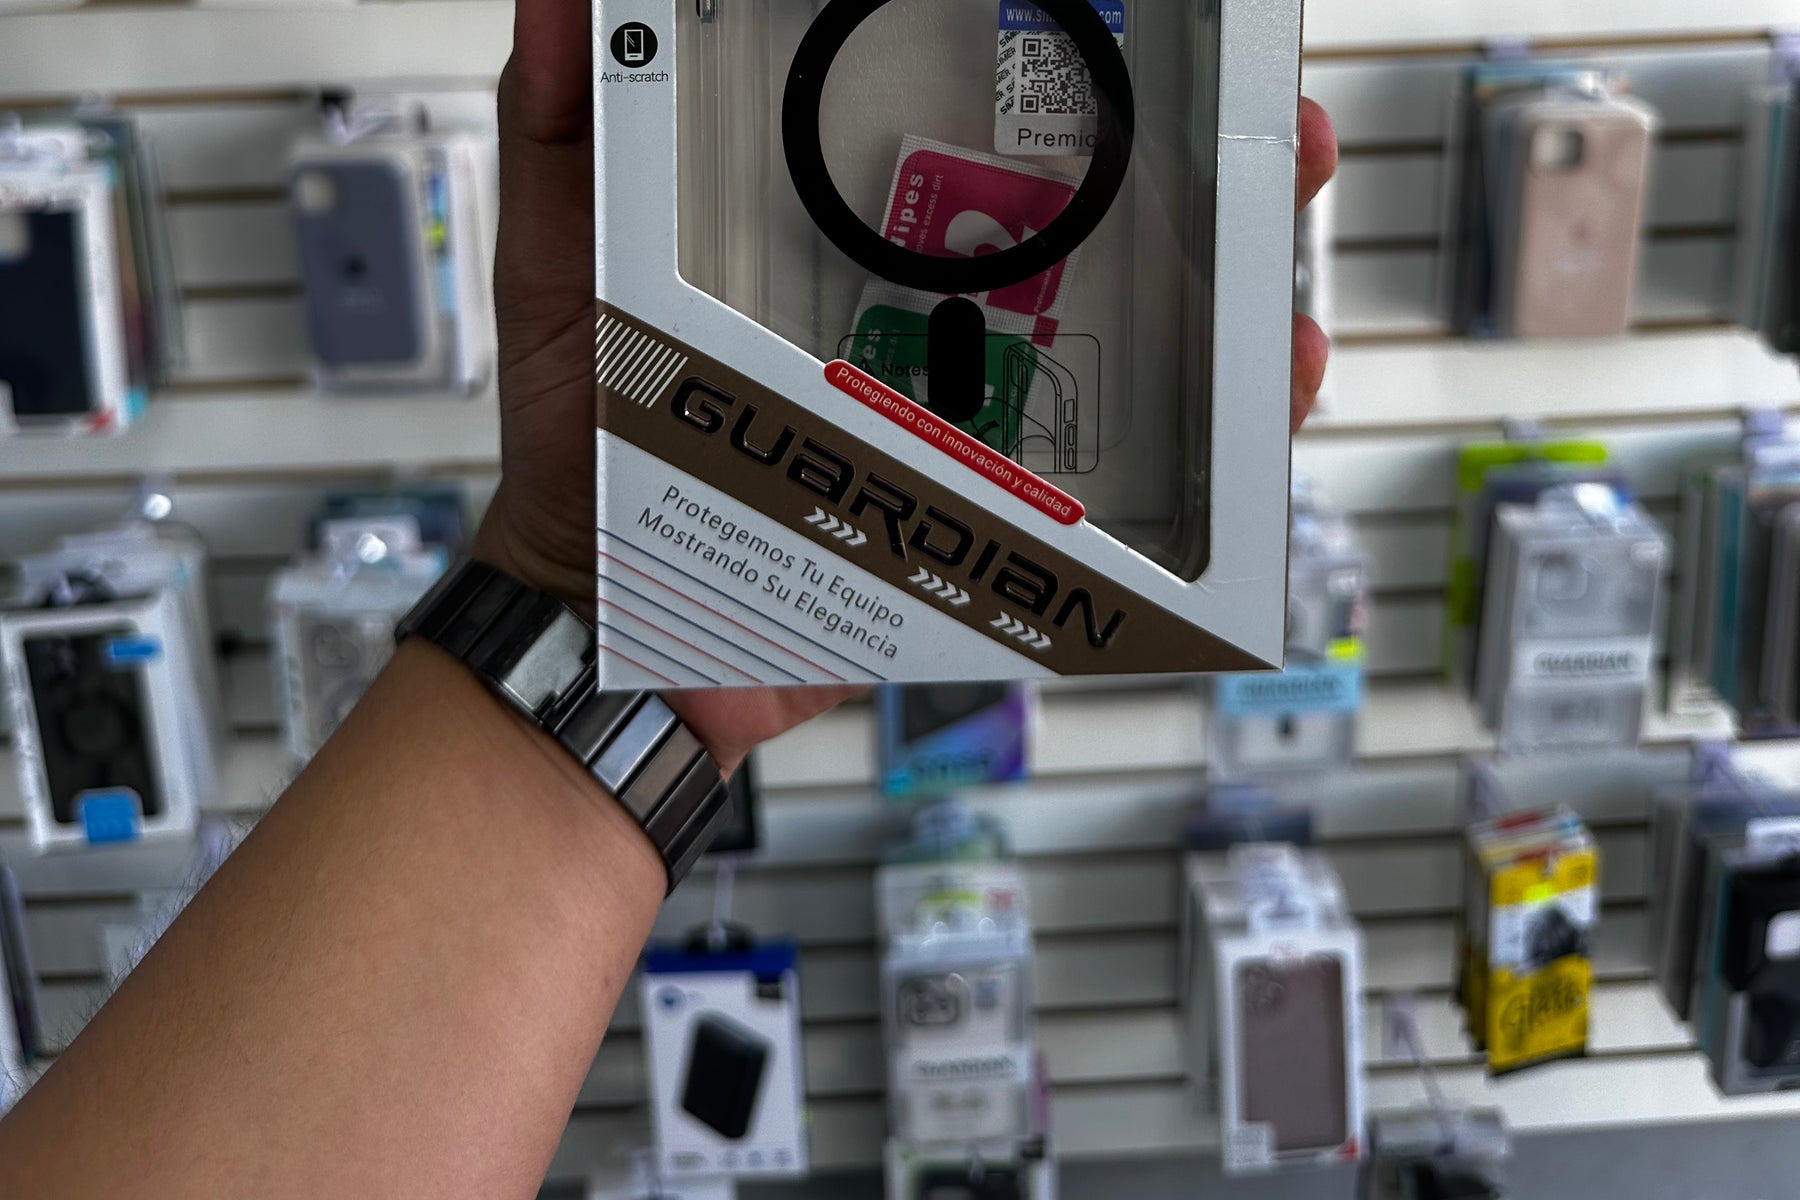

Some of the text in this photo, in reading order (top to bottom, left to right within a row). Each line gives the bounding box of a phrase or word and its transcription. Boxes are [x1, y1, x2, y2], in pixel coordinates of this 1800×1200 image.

[601, 71, 669, 84] Anti-scratch
[836, 367, 1072, 517] Protegiendo con innovación y calidad
[638, 507, 899, 658] Mostrando Su Elegancia
[662, 485, 904, 629] Protegemos Tu Equipo
